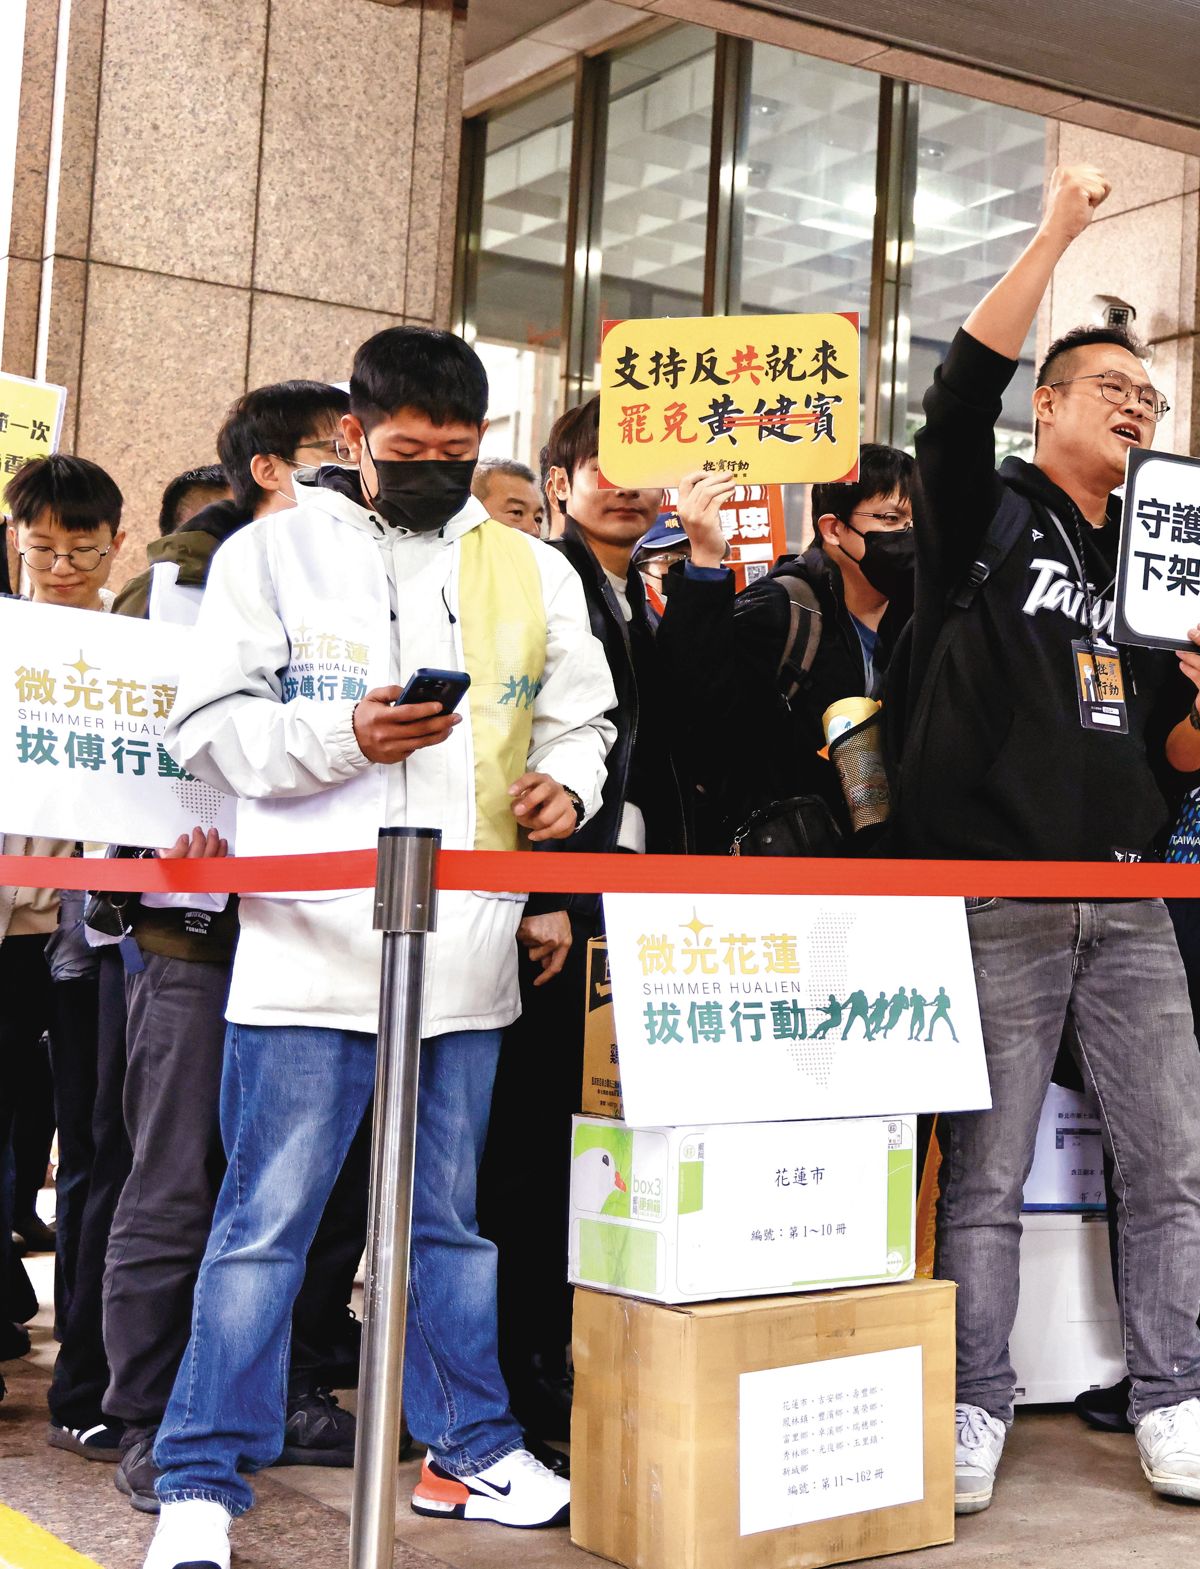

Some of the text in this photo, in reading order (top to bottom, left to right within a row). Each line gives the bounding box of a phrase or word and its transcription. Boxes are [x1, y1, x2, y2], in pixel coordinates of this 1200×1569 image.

[610, 340, 849, 390] 支持反共就來
[318, 663, 368, 676] HUALIEN
[14, 665, 180, 720] 微光花蓮
[18, 708, 165, 737] SHIMMER HUAL
[636, 933, 801, 976] 微光花蓮
[642, 981, 801, 996] SHIMMER HUALIEN
[643, 998, 809, 1045] 拔傅行動
[633, 1174, 661, 1197] box3
[775, 1167, 826, 1187] 花蓮市
